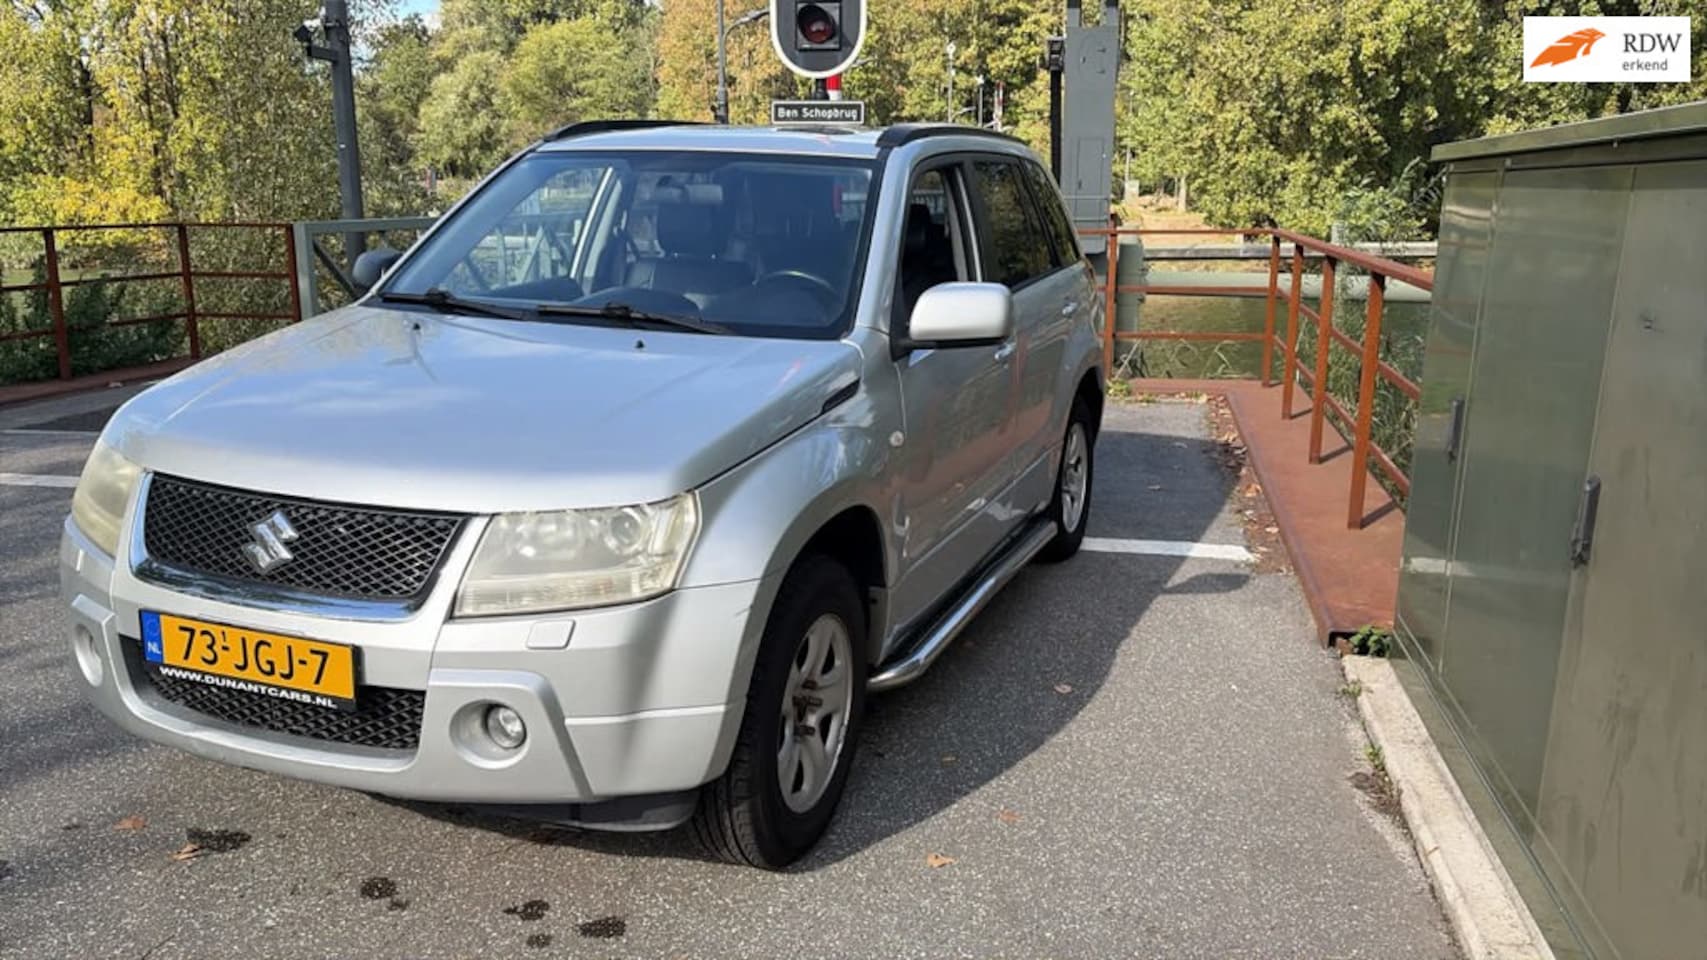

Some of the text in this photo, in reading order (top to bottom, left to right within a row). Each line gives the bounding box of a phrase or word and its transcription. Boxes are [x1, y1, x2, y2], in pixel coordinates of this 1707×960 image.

[777, 107, 858, 120] Ben Schopbrug
[147, 641, 161, 655] NL
[178, 626, 329, 686] 73-JGJ-7
[160, 666, 338, 709] WWW.DUNANTCARS.NL
